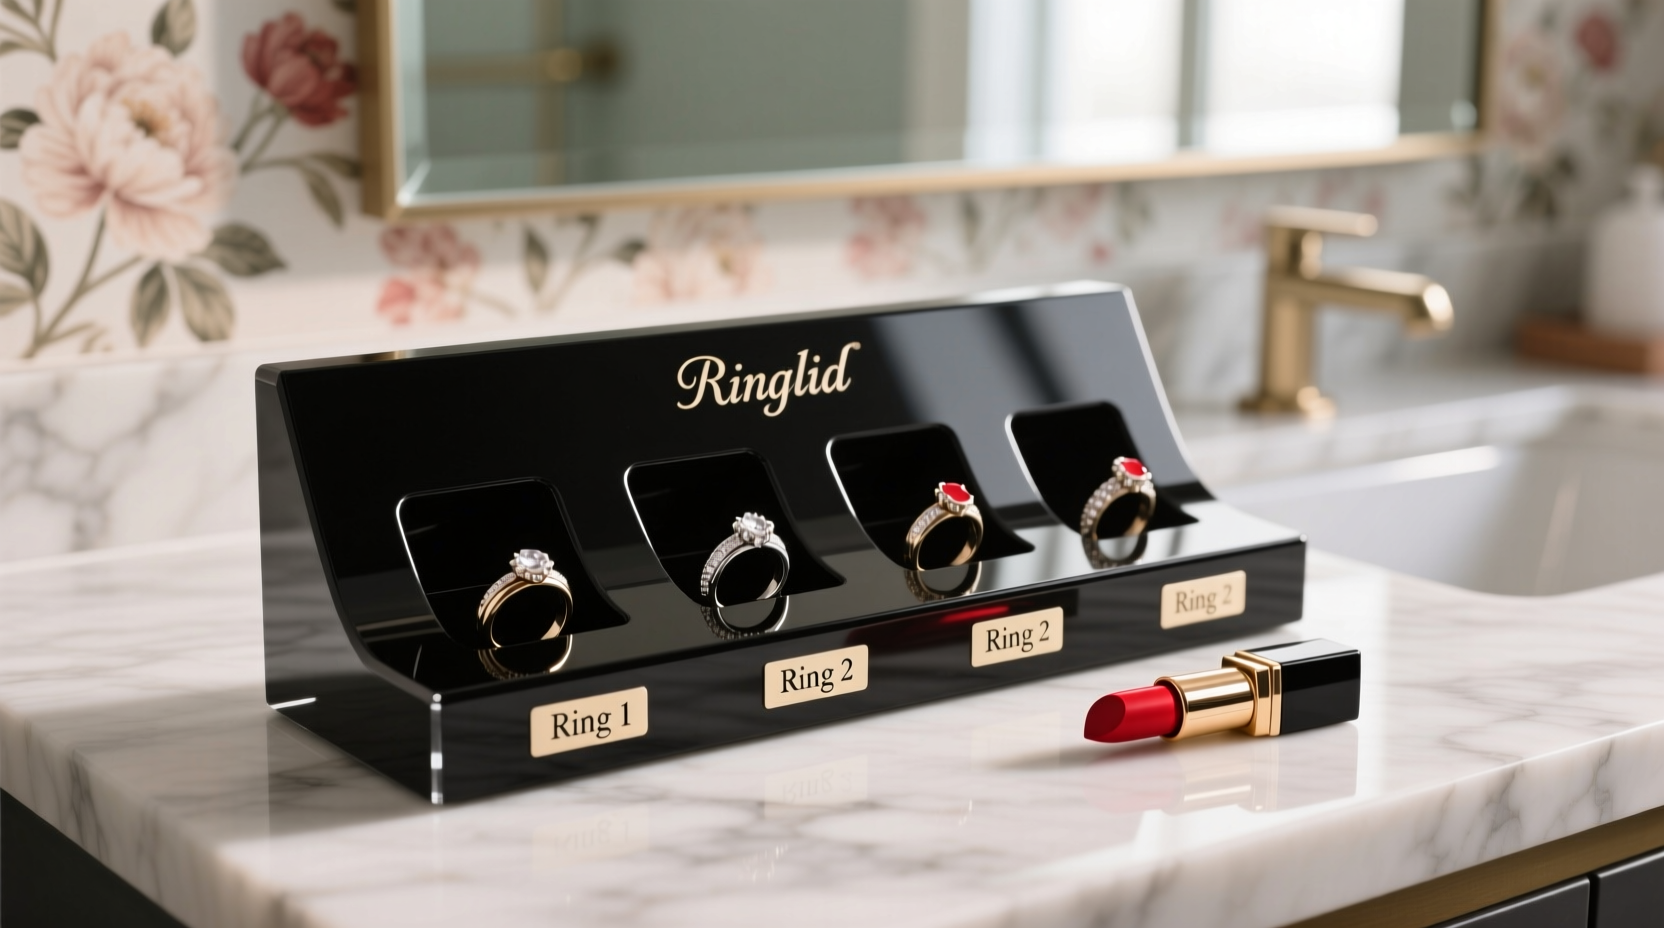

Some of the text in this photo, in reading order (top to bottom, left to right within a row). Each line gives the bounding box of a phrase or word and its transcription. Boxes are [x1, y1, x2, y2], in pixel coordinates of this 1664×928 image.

[677, 341, 861, 417] Ringlid
[1174, 585, 1233, 615] Ring 2
[985, 620, 1050, 653] Ring 2
[780, 658, 854, 694] Ring 2
[551, 702, 632, 740] Ring 1
